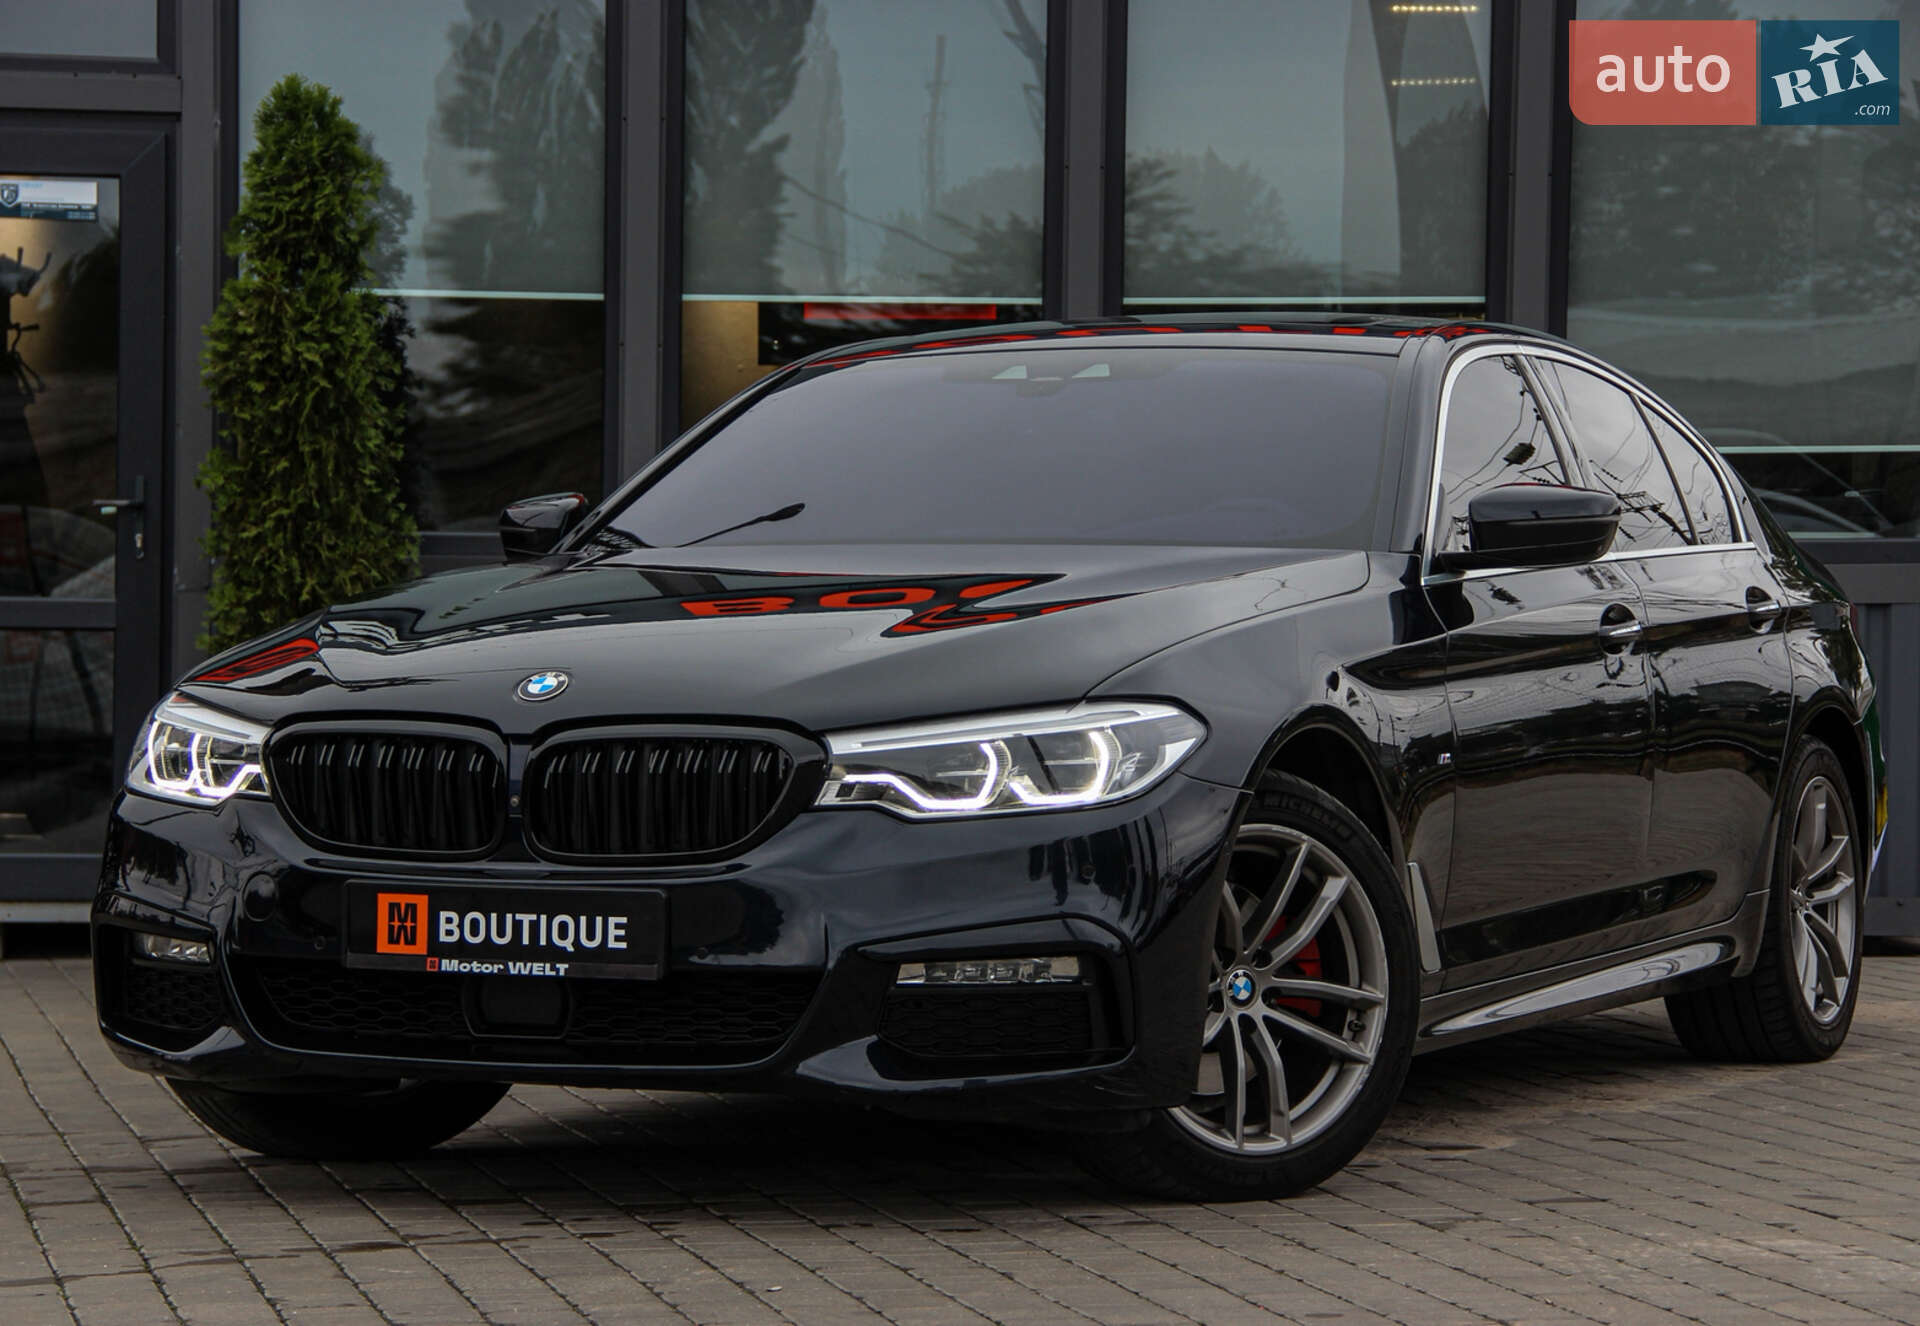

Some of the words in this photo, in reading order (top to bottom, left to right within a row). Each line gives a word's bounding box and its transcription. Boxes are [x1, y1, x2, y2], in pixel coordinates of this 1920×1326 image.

[439, 911, 628, 952] BOUTIQUE
[441, 959, 504, 974] Motor
[507, 961, 569, 976] WELT
